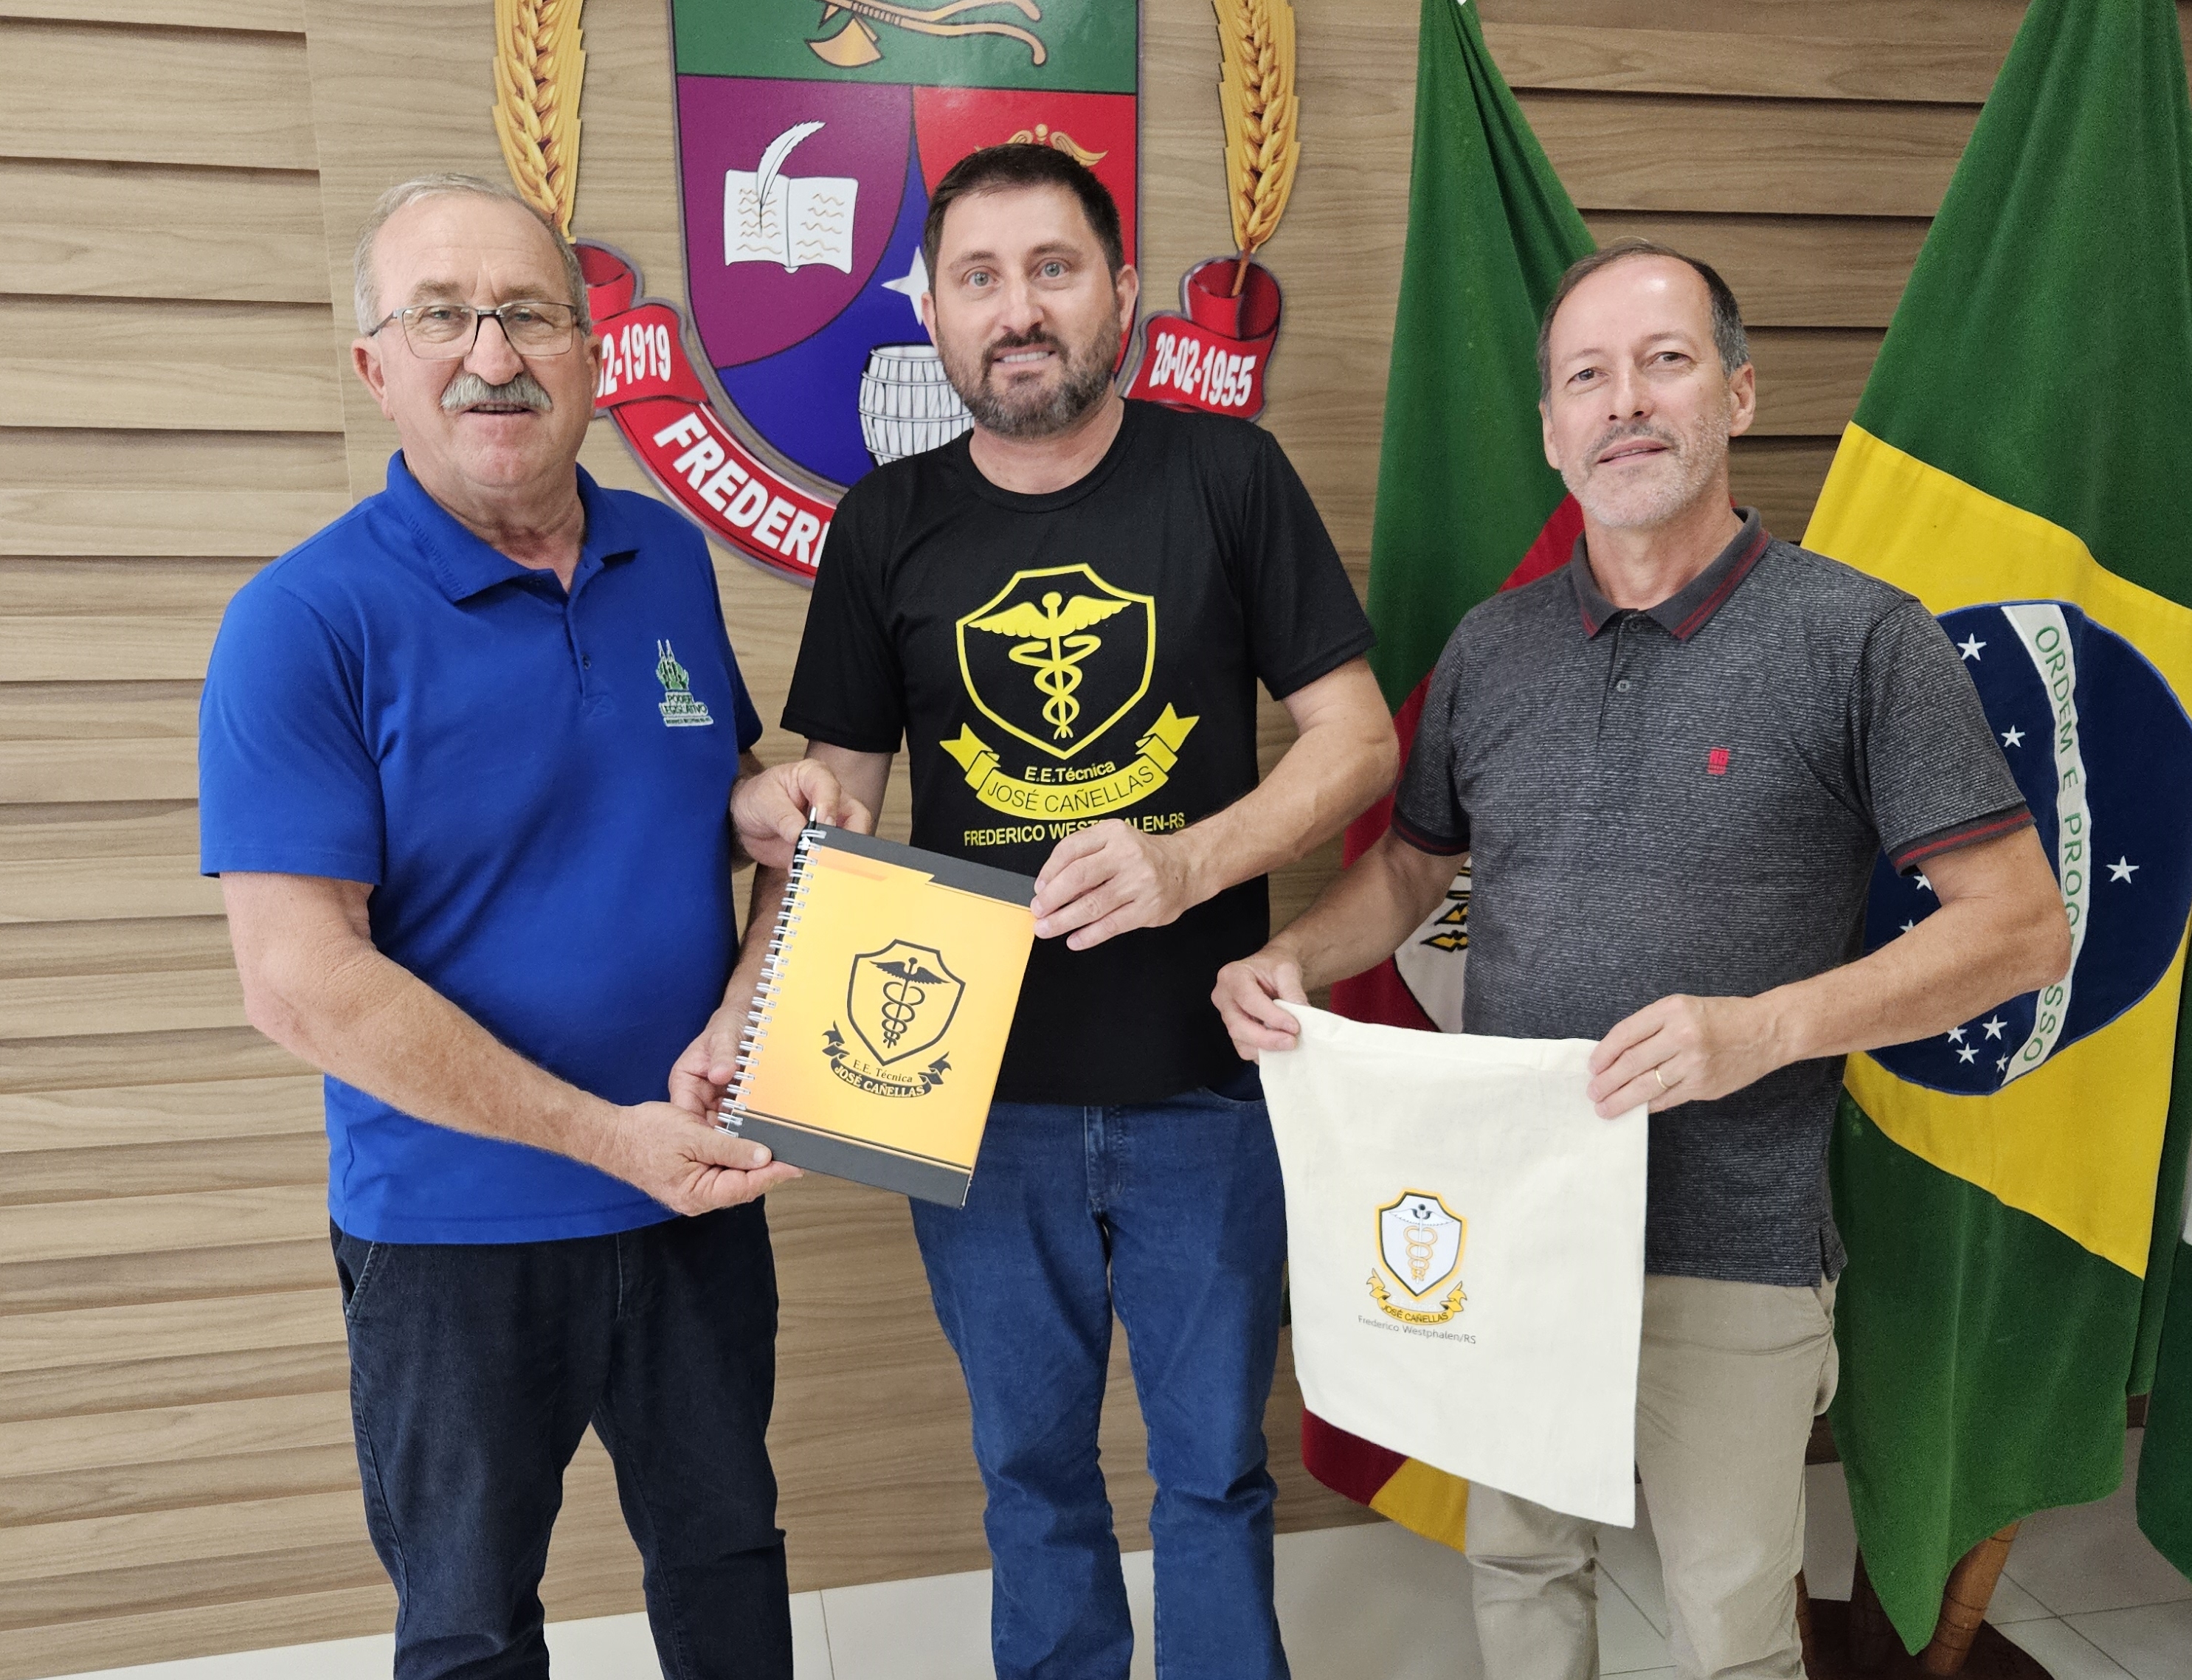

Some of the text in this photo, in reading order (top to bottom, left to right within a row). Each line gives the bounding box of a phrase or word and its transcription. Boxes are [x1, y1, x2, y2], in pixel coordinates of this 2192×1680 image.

[1149, 331, 1256, 406] 28-02-1955
[1024, 761, 1116, 783] E.E.Técnica
[986, 765, 1155, 813] JOSÉ CAÑELLAS
[964, 823, 1045, 846] FREDERICO
[2023, 626, 2083, 1062] ORDEM E PROGSSO
[835, 1066, 925, 1098] JOSÉ CAÑELLAS
[876, 1068, 913, 1083] Técnica
[1381, 1304, 1449, 1324] JOSÉ CAÑELLAS
[1358, 1315, 1476, 1344] Frederico Westphalen/RS
